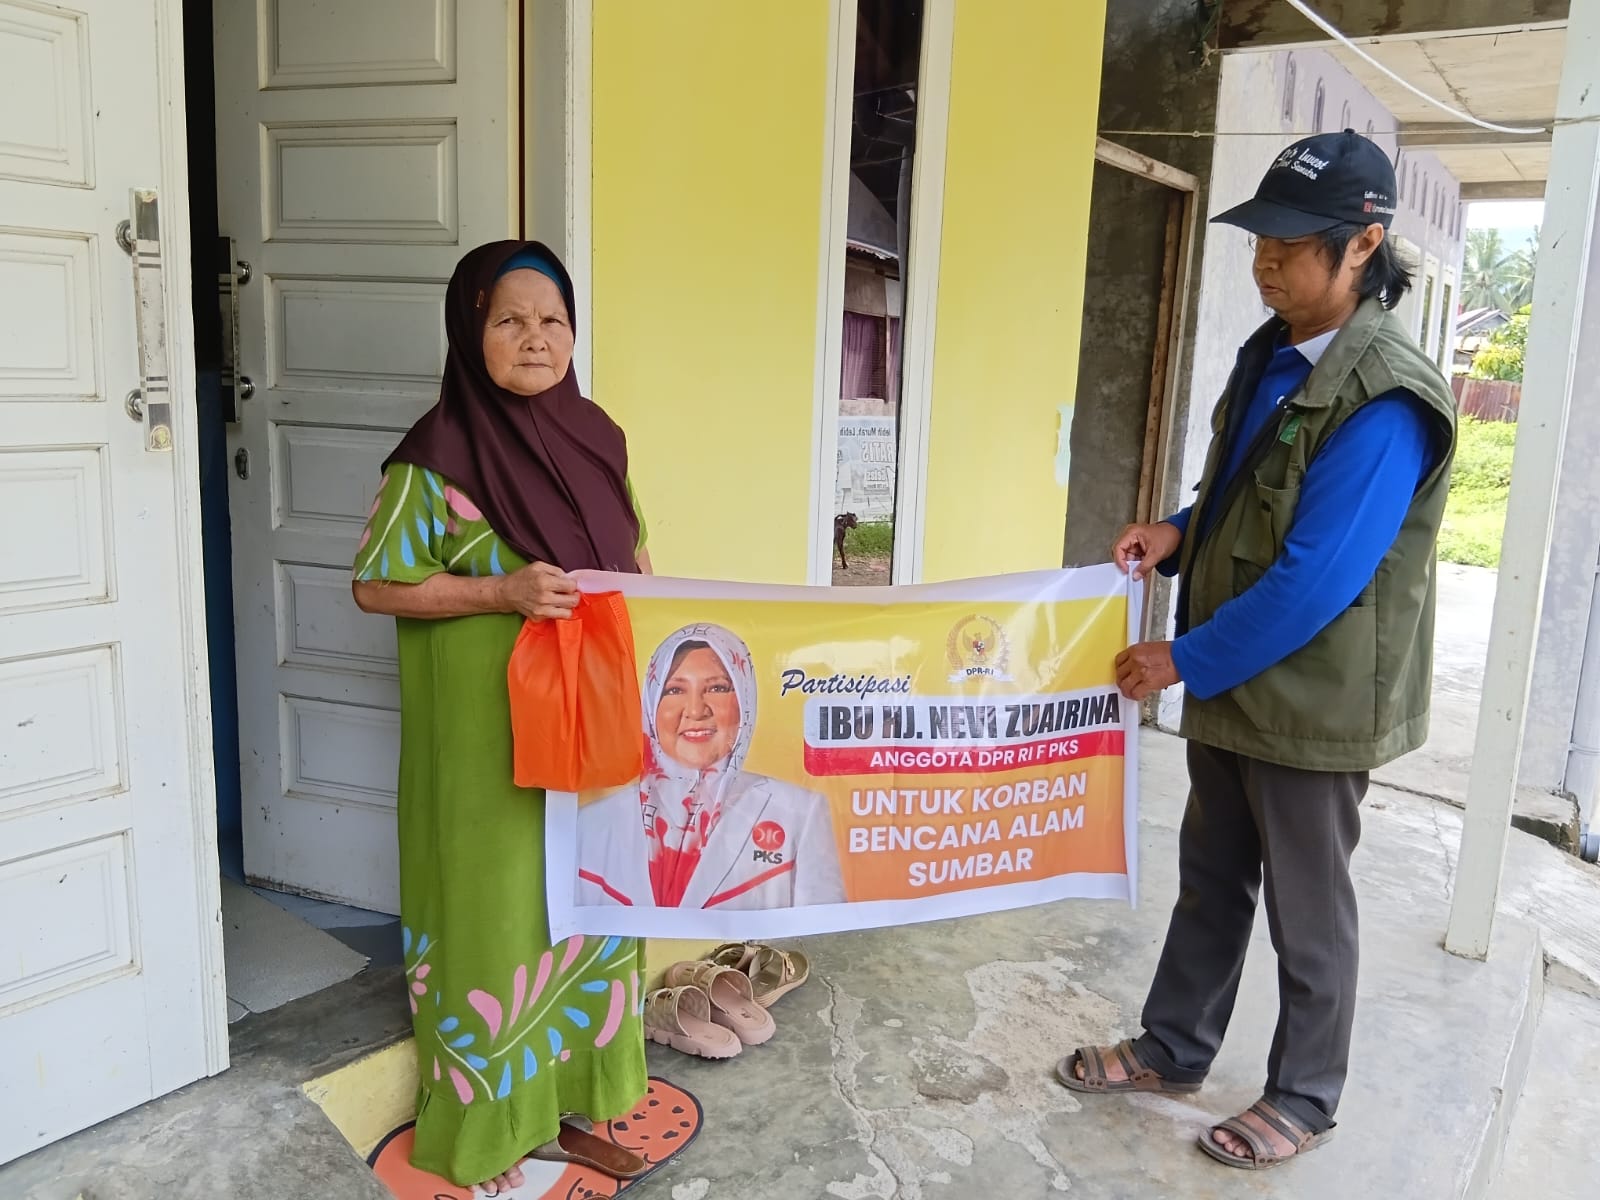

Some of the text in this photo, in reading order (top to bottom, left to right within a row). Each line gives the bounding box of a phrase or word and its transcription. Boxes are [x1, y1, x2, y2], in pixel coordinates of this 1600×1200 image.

[781, 669, 912, 699] Partisipasi
[966, 667, 994, 676] DPR-RI
[818, 692, 1121, 740] IBU HJ. NEVI ZUAIRINA
[870, 739, 1079, 768] ANGGOTA DPR RI F PKS
[852, 772, 1087, 816] UNTUK KORBAN
[849, 805, 1085, 853] BENCANA ALAM
[753, 850, 783, 864] PKS
[908, 848, 1033, 887] SUMBAR
